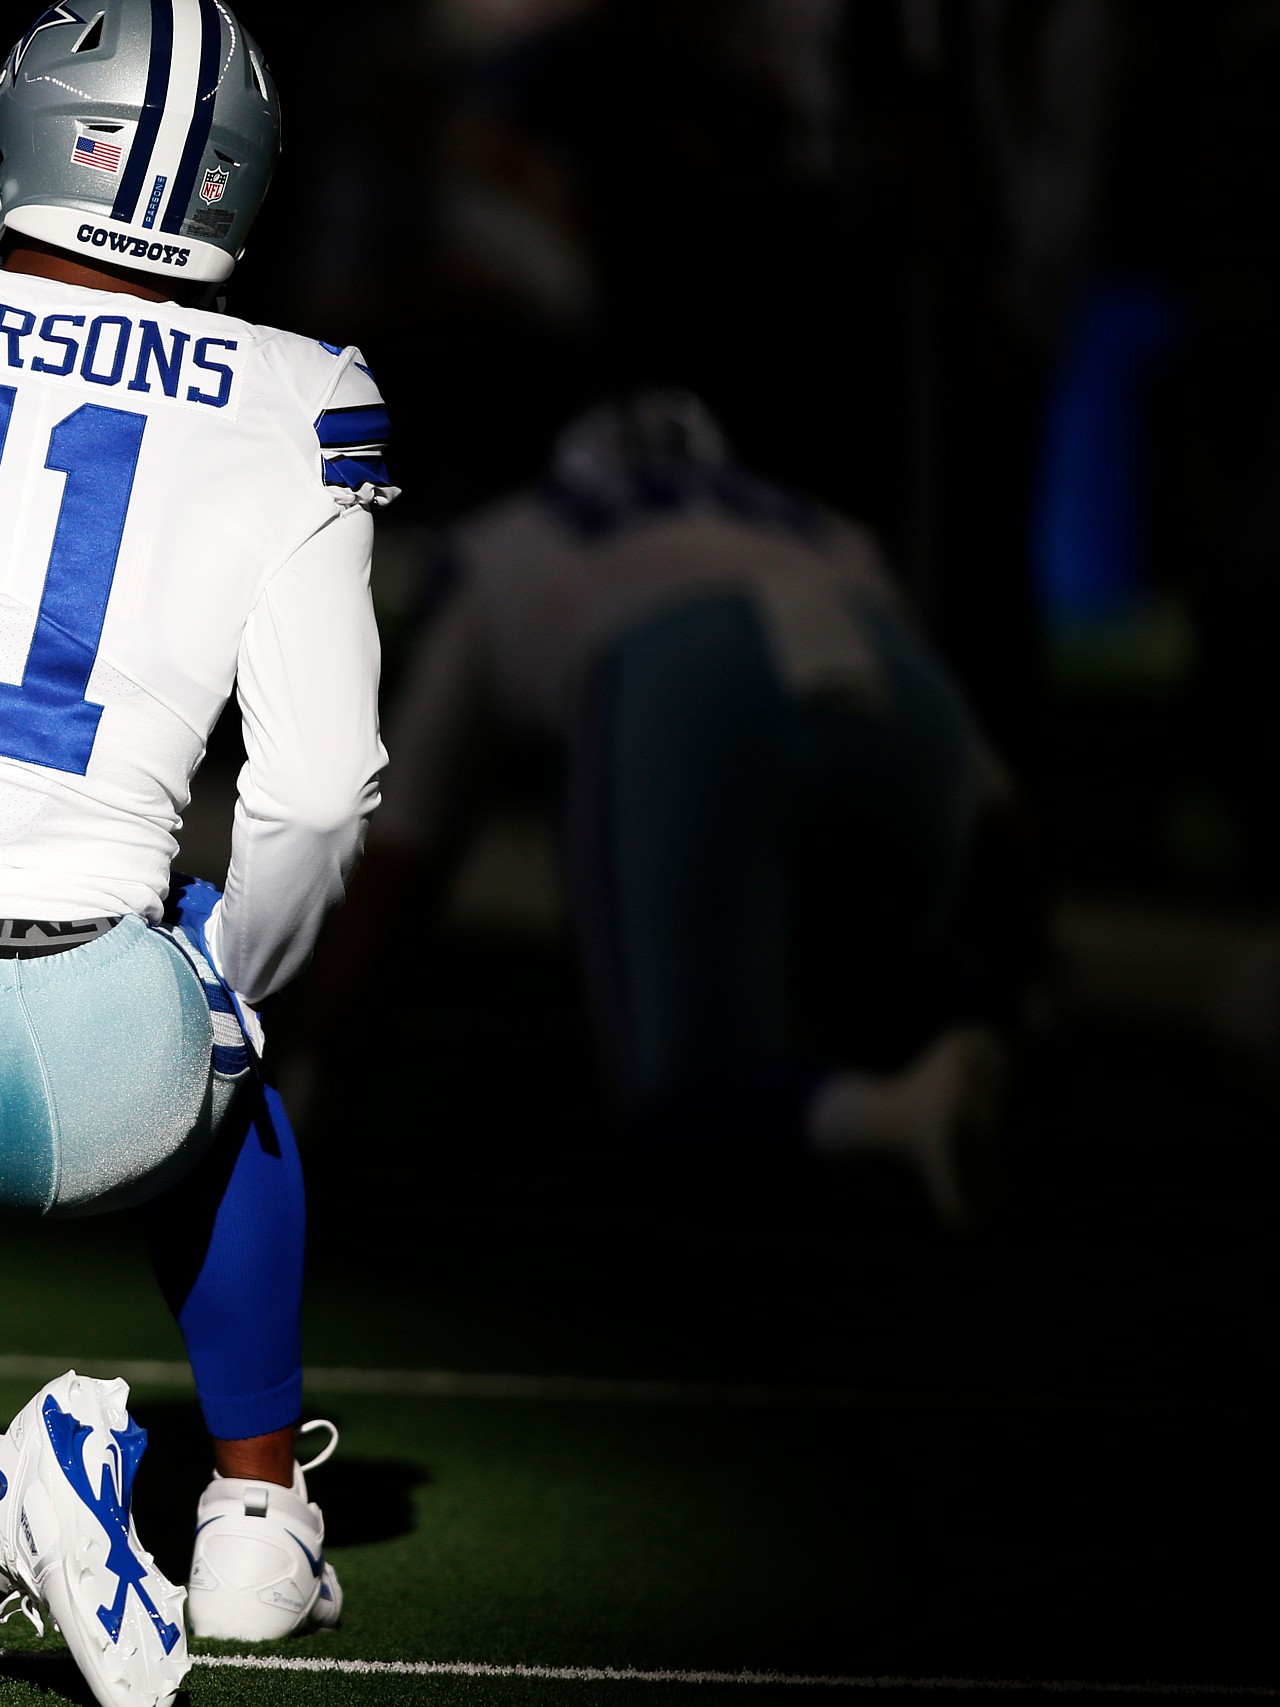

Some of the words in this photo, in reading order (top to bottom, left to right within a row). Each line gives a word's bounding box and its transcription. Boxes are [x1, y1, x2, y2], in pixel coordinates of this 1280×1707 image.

[145, 177, 166, 223] PARSONS
[203, 183, 222, 199] NFL
[76, 224, 191, 267] COWBOYS
